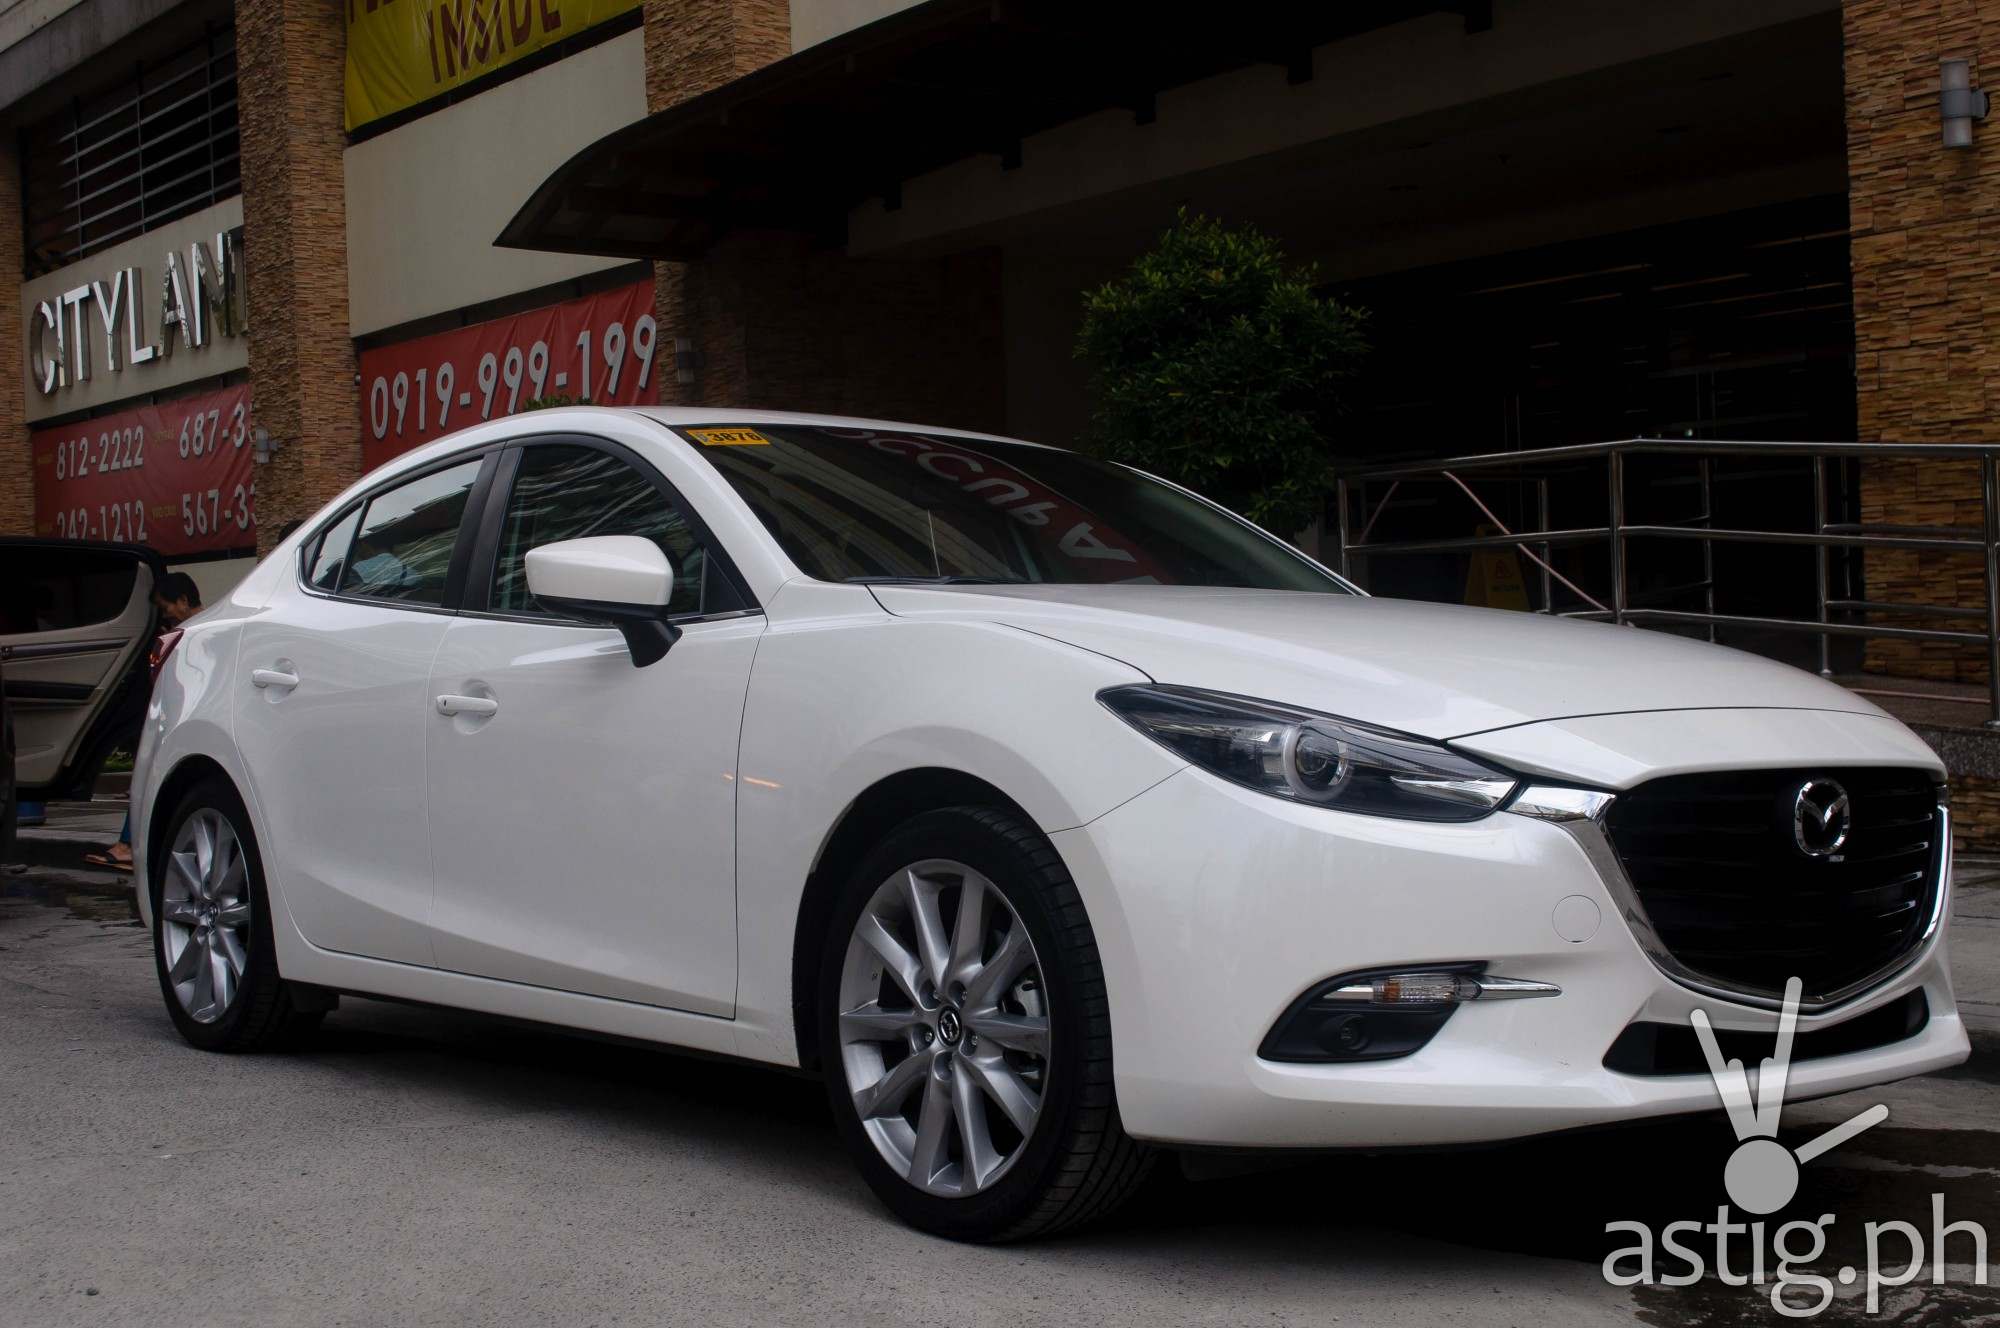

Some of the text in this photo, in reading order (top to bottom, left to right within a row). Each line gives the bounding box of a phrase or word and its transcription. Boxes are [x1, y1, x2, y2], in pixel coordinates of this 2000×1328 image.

[370, 314, 657, 440] 0919-999-199
[56, 425, 144, 481] 812-2222
[179, 402, 254, 459] 687-3
